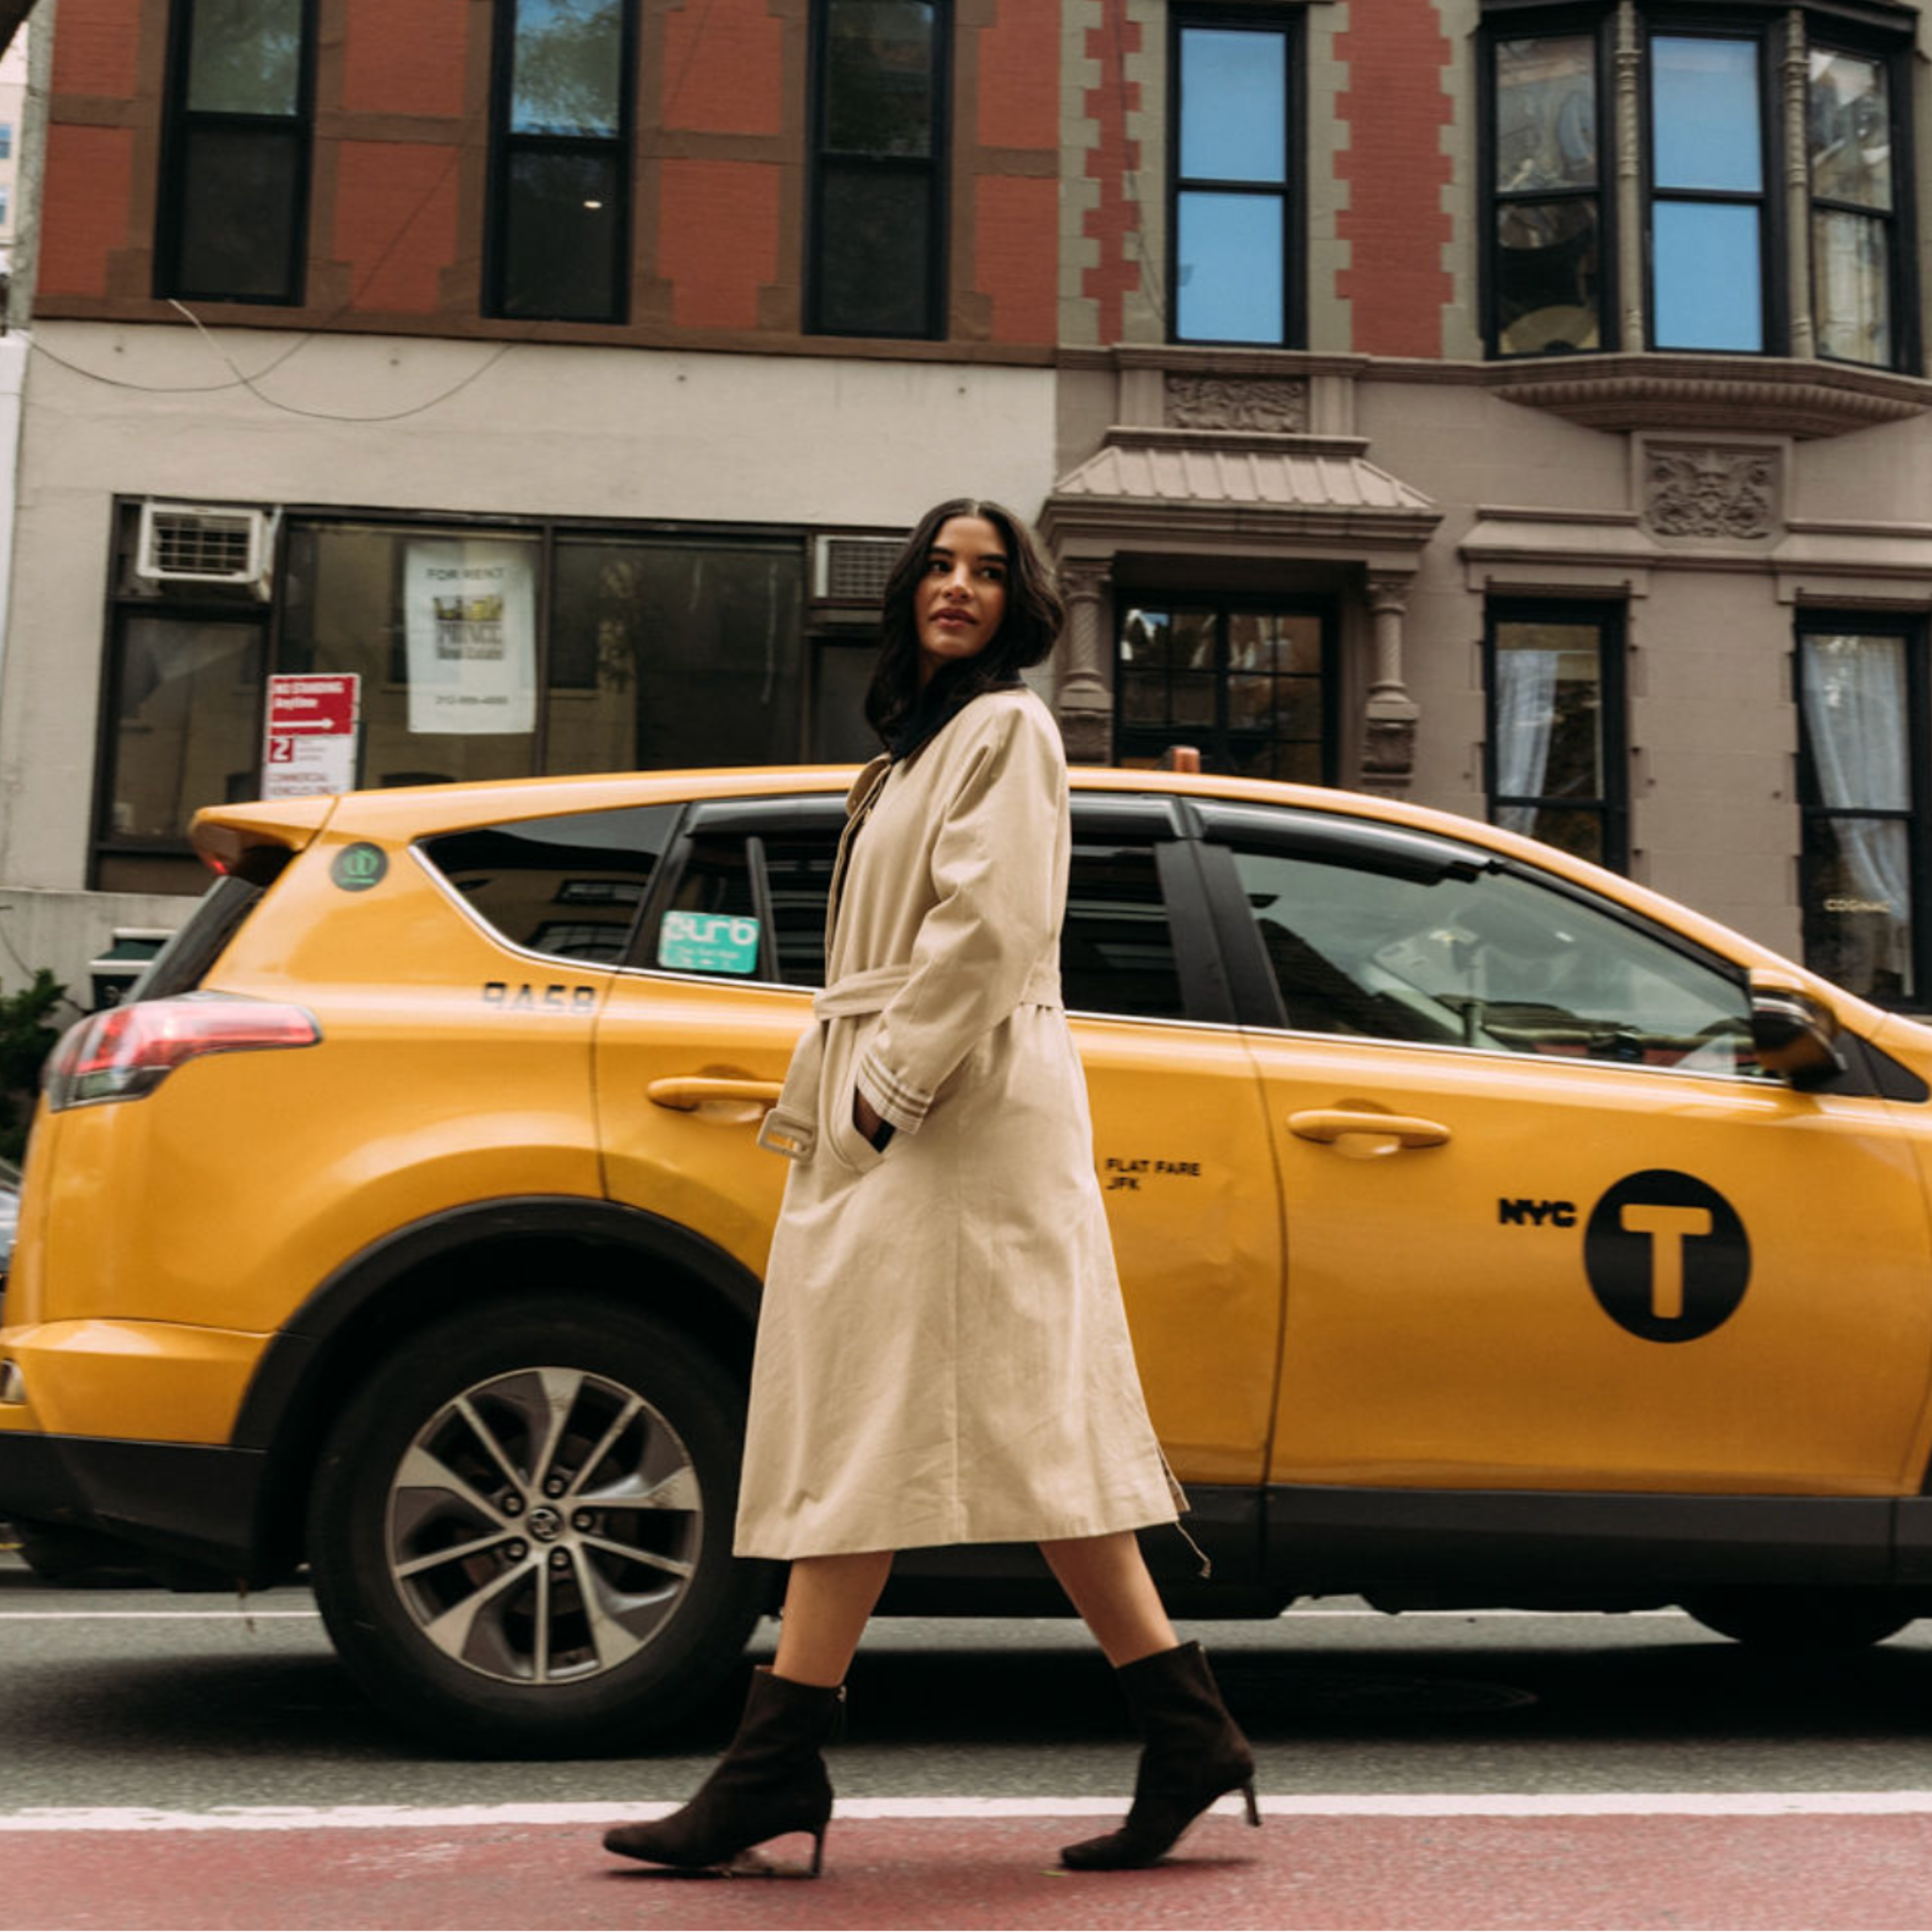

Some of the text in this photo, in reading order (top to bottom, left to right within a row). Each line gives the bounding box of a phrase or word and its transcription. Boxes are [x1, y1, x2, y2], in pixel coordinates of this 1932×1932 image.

[427, 567, 503, 581] FOR RENT
[272, 738, 289, 761] 2
[1105, 1158, 1201, 1177] FLAT FARE
[1105, 1177, 1141, 1191] JFK
[1497, 1198, 1713, 1319] NYC T
